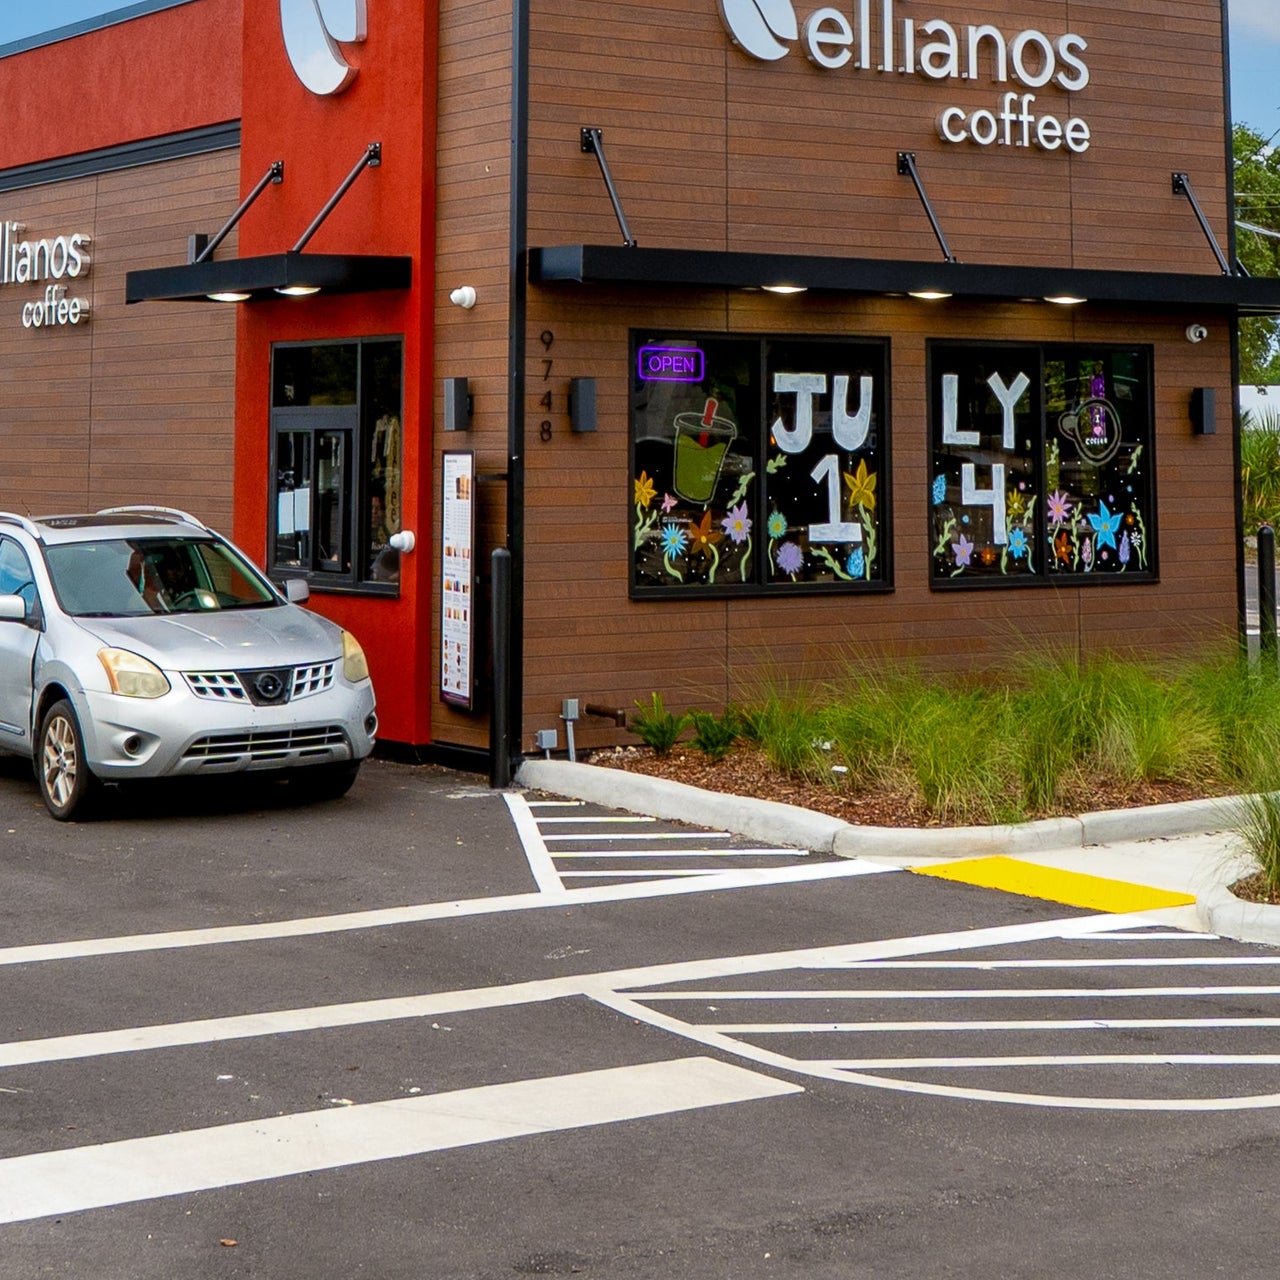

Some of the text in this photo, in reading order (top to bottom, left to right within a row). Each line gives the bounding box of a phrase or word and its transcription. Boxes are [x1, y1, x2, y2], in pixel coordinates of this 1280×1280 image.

[936, 91, 1091, 153] coffee
[22, 284, 87, 328] coffee
[648, 355, 695, 373] OPEN
[771, 371, 1031, 453] JU LY
[808, 454, 1009, 545] 1 4
